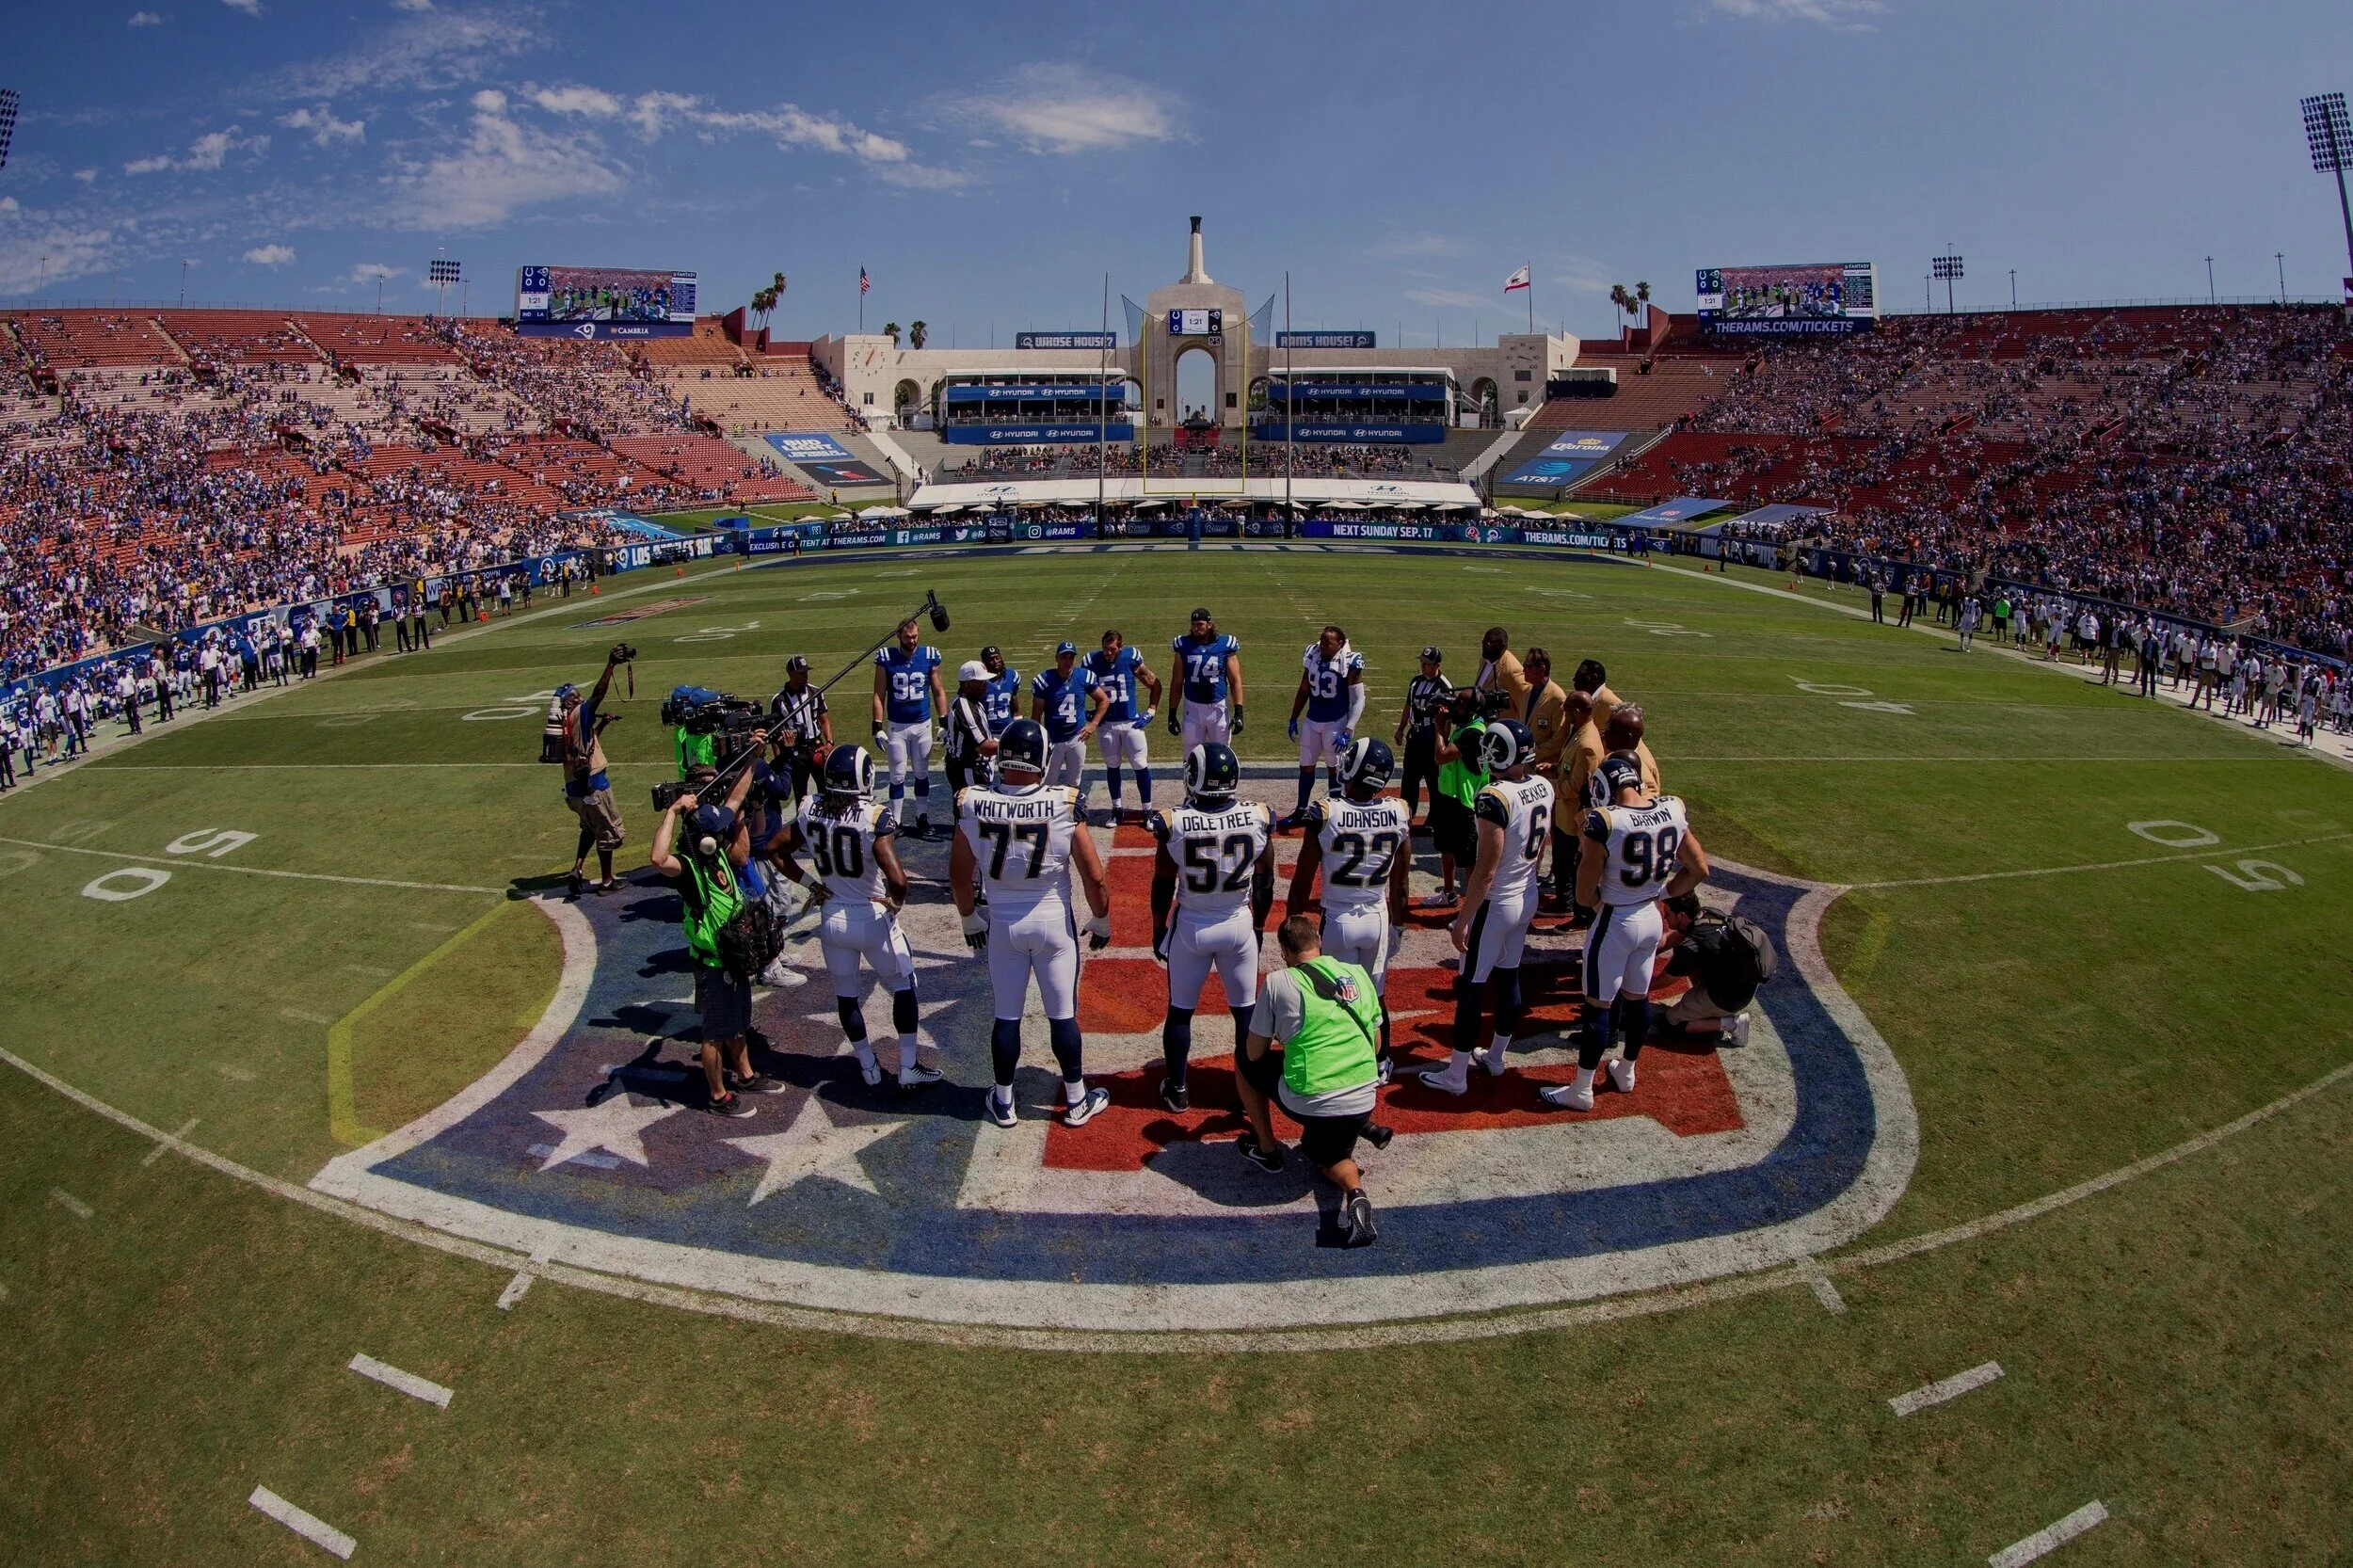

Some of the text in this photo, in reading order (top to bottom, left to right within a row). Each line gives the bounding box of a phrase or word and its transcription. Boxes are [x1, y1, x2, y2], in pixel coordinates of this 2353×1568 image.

[525, 278, 546, 286] 0 0
[1712, 280, 1719, 288] 0
[1715, 321, 1854, 333] THERAMS.COM/TICKETS
[1034, 336, 1072, 347] WHOSE
[1281, 336, 1353, 347] RAMS HOUSE!
[1551, 442, 1610, 452] Corona
[912, 532, 941, 542] @RAMS
[971, 530, 986, 538] @RA
[1046, 527, 1076, 536] @RAMS
[1333, 524, 1433, 538] NEXT SUNDAY SEP. 17
[749, 535, 887, 552] EXCLUSIE CTENT AT THERAMS.COM
[632, 546, 650, 566] LOS
[1187, 655, 1220, 683] 74
[892, 672, 926, 700] 92
[1098, 673, 1129, 703] 51
[1307, 670, 1337, 699] 93
[988, 693, 1012, 721] 13
[1058, 694, 1077, 724] 4
[1517, 783, 1549, 806] HEKKER
[973, 799, 1055, 819] WHITWORTH
[1337, 809, 1398, 828] JOHNSON
[1629, 808, 1673, 827] BARWIN
[1182, 811, 1254, 832] OGLETREE
[1525, 805, 1547, 860] 6
[807, 821, 865, 878] 30
[978, 820, 1049, 881] 77
[1620, 826, 1678, 888] 98
[2127, 820, 2304, 891] 50
[82, 828, 259, 902] 50
[1184, 833, 1256, 893] 52
[1330, 833, 1399, 888] 22
